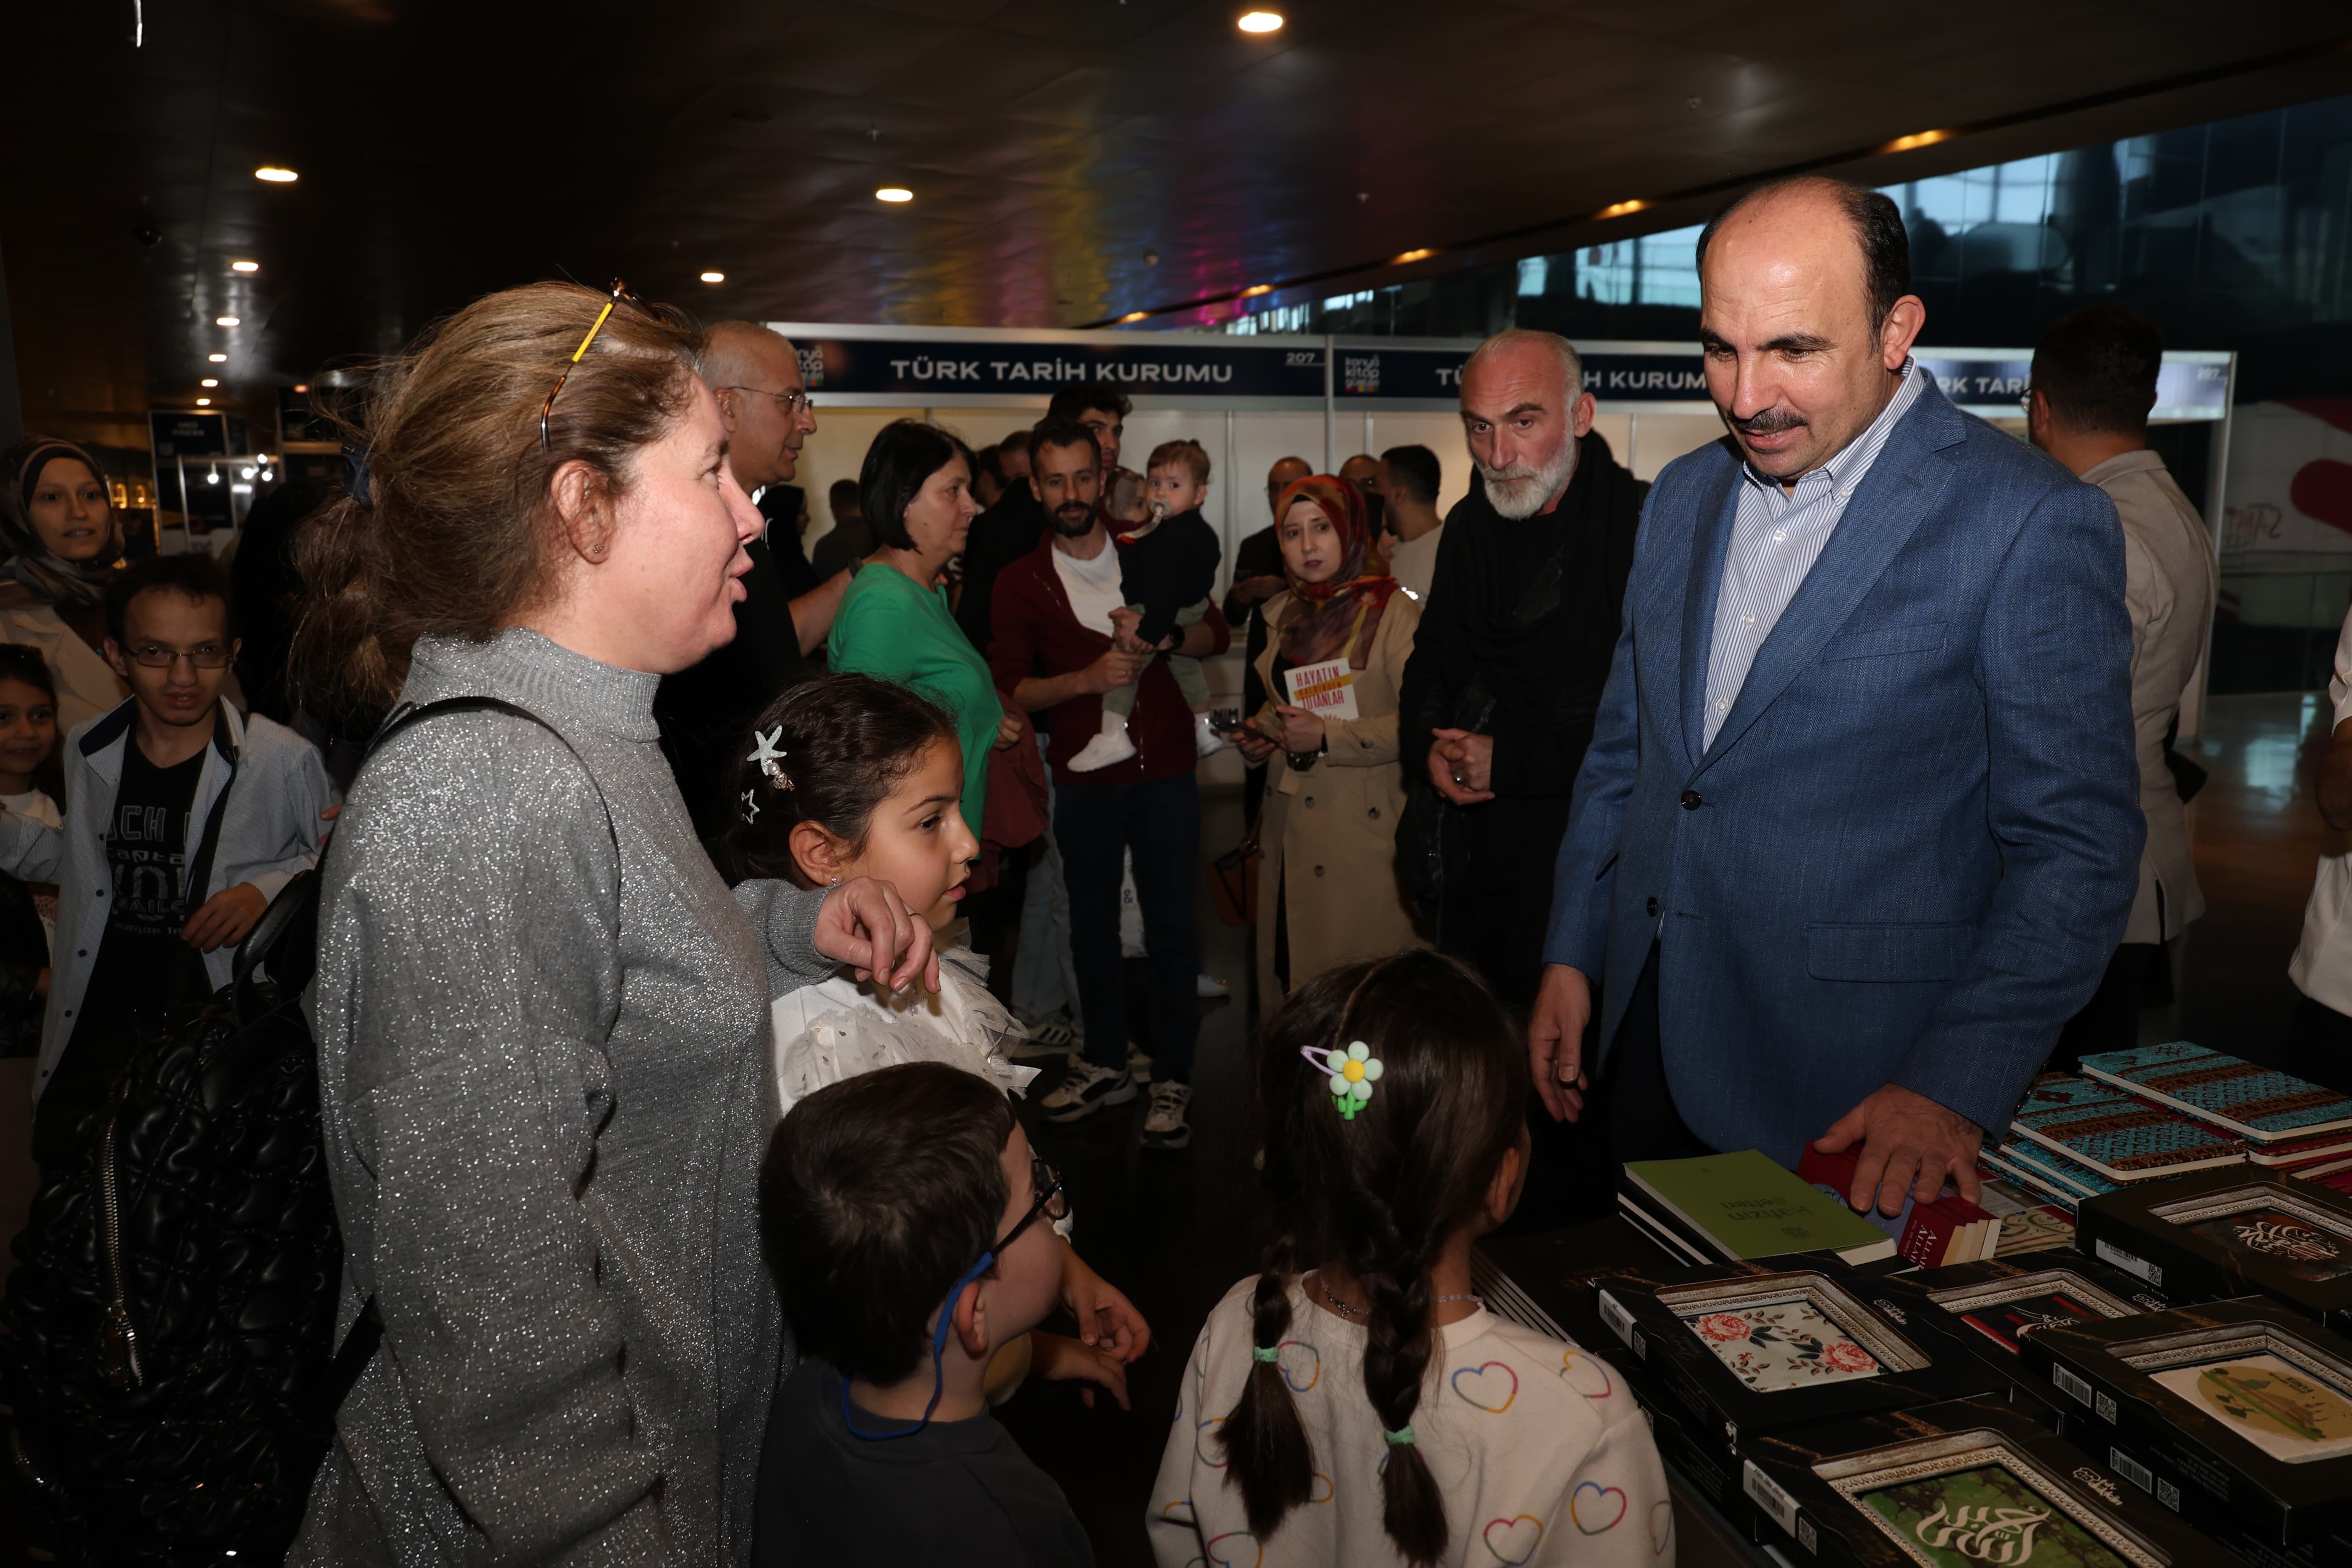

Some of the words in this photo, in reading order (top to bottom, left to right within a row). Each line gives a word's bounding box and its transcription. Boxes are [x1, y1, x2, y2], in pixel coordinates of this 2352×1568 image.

[1285, 352, 1316, 364] 207
[889, 356, 981, 380] TÜRK
[989, 357, 1086, 381] TARİH
[1095, 362, 1233, 383] KURUMU
[1609, 370, 1707, 390] KURUM
[1296, 666, 1340, 687] HAYATIN
[1301, 689, 1345, 710] TUTANLAR
[1910, 1224, 1928, 1263] ALLAH
[1918, 1229, 1937, 1270] ALLAH
